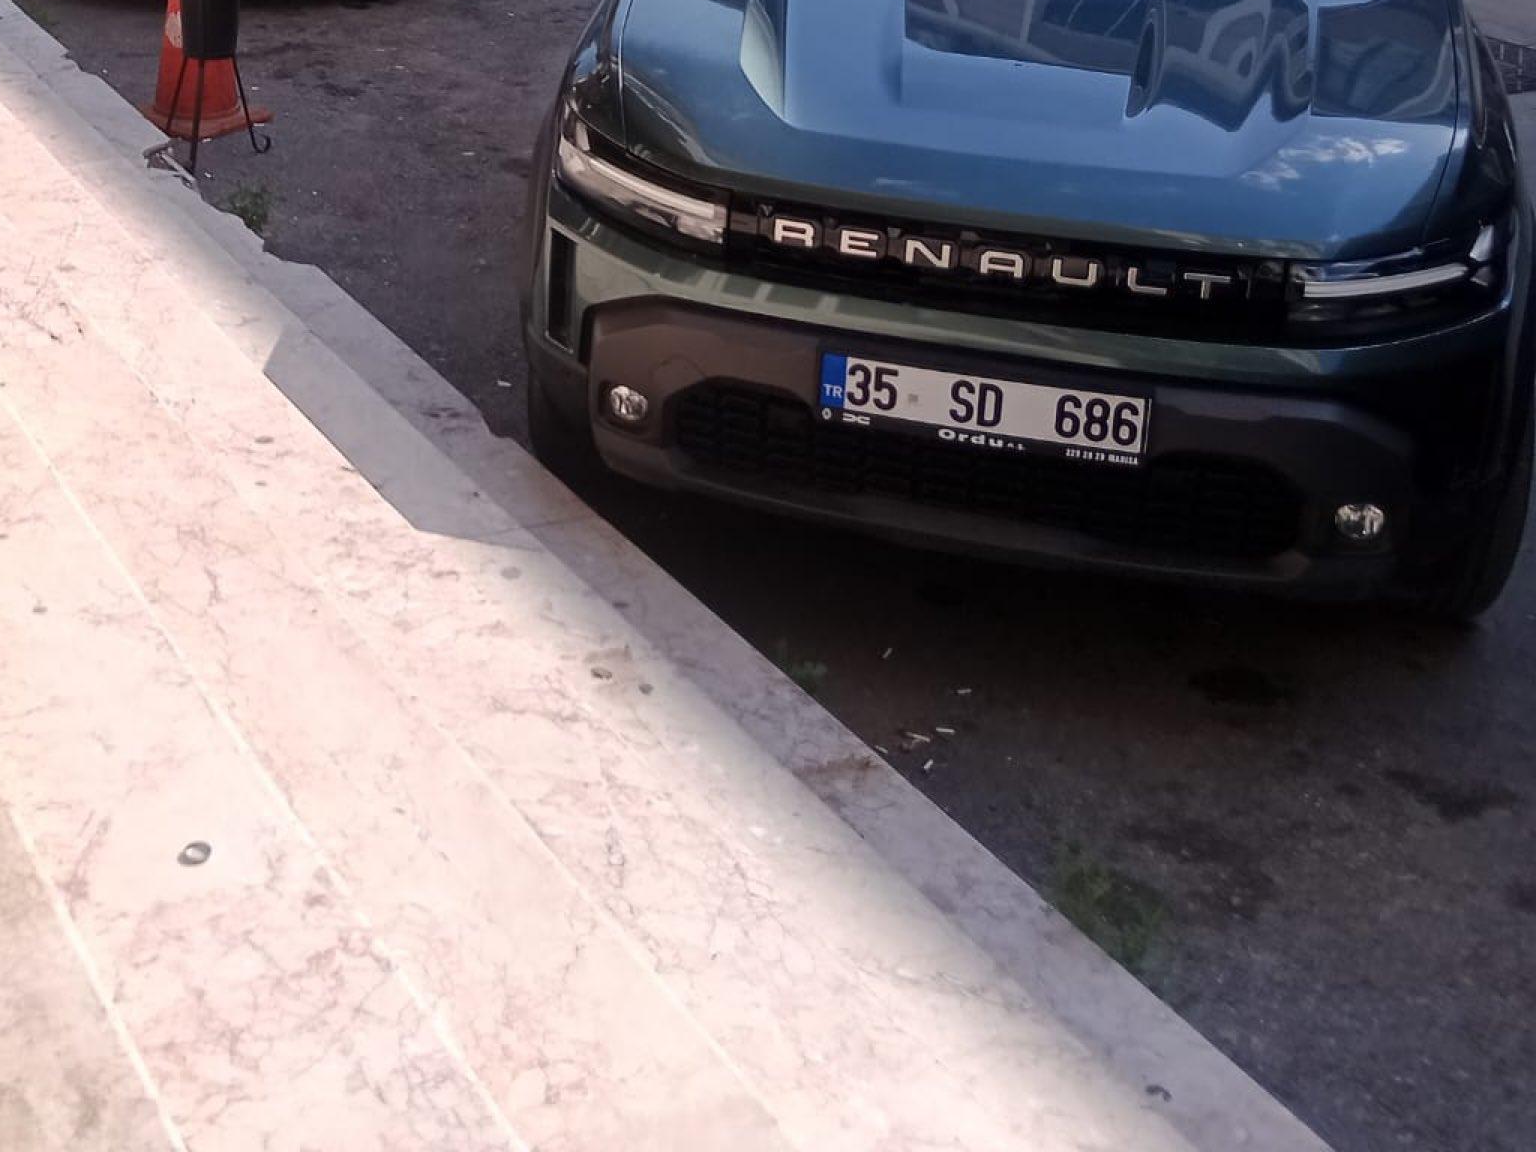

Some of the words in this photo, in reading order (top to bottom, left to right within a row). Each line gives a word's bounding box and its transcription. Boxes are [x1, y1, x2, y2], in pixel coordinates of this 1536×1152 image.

[773, 218, 1232, 300] RENAULT
[823, 384, 842, 398] TR
[846, 363, 899, 411] 35
[949, 379, 1003, 428] SD
[1055, 394, 1140, 447] 686
[938, 428, 1004, 448] Ordu
